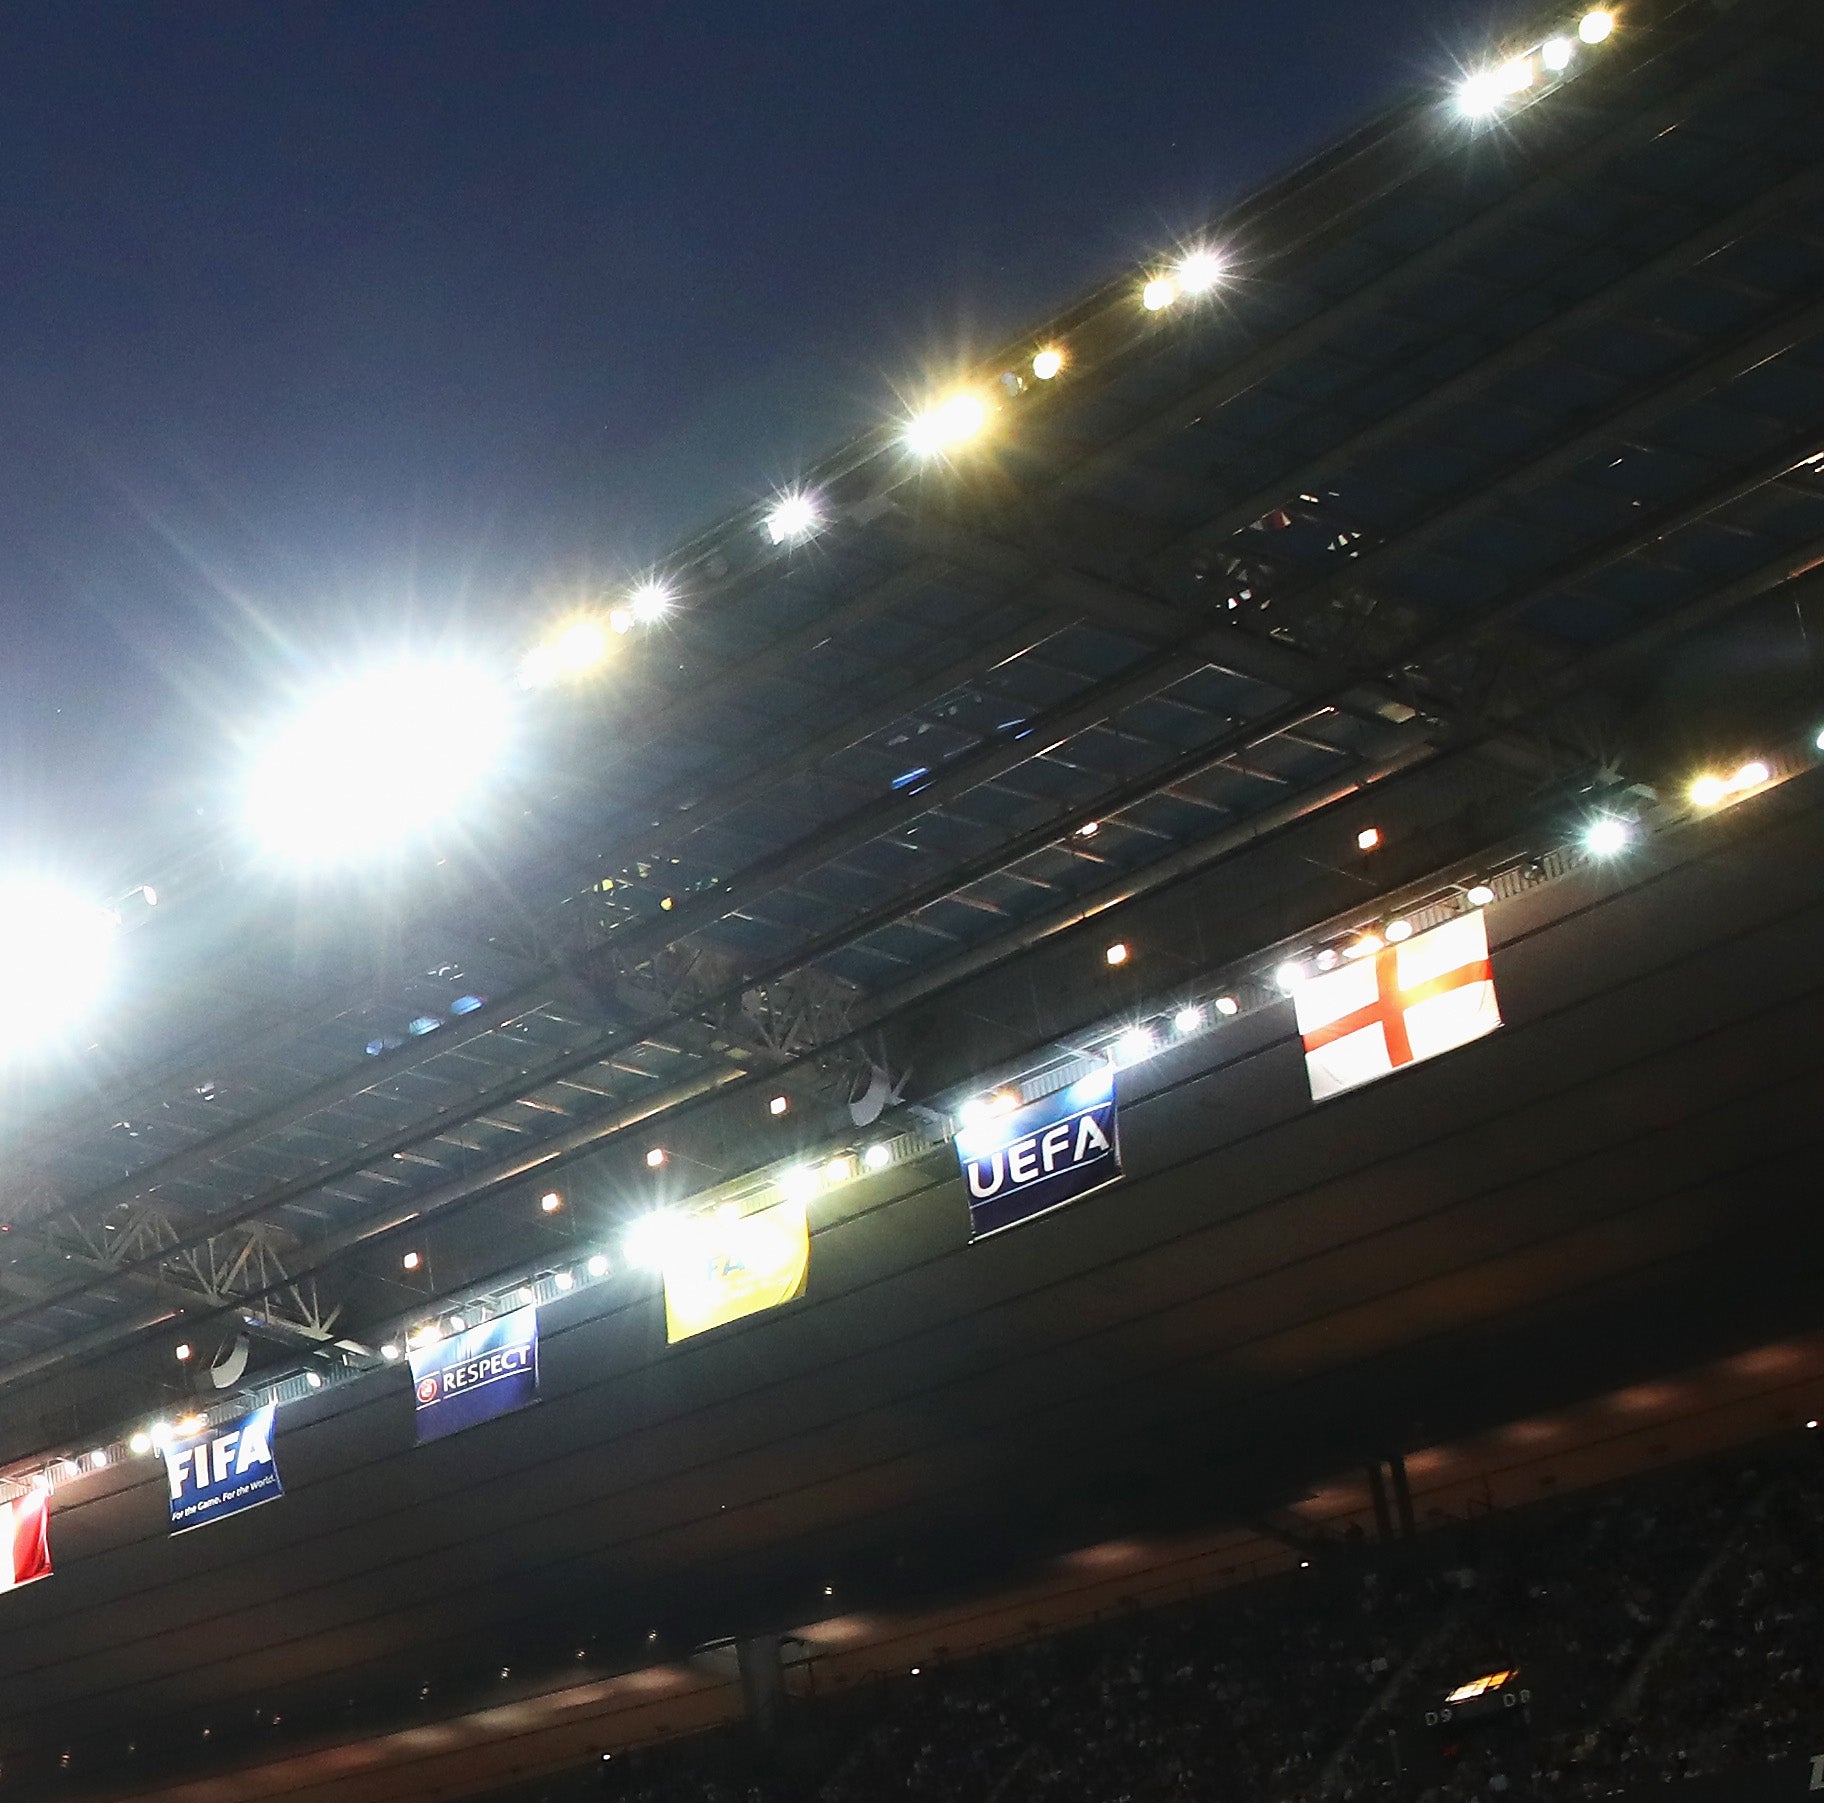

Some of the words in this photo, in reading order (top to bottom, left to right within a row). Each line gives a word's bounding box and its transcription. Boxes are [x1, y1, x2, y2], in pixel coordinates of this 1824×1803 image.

[967, 1115, 1110, 1199] UEFA
[443, 1345, 531, 1392] RESPECT
[167, 1425, 272, 1500] FIFA
[222, 1490, 235, 1502] For
[236, 1483, 250, 1497] the
